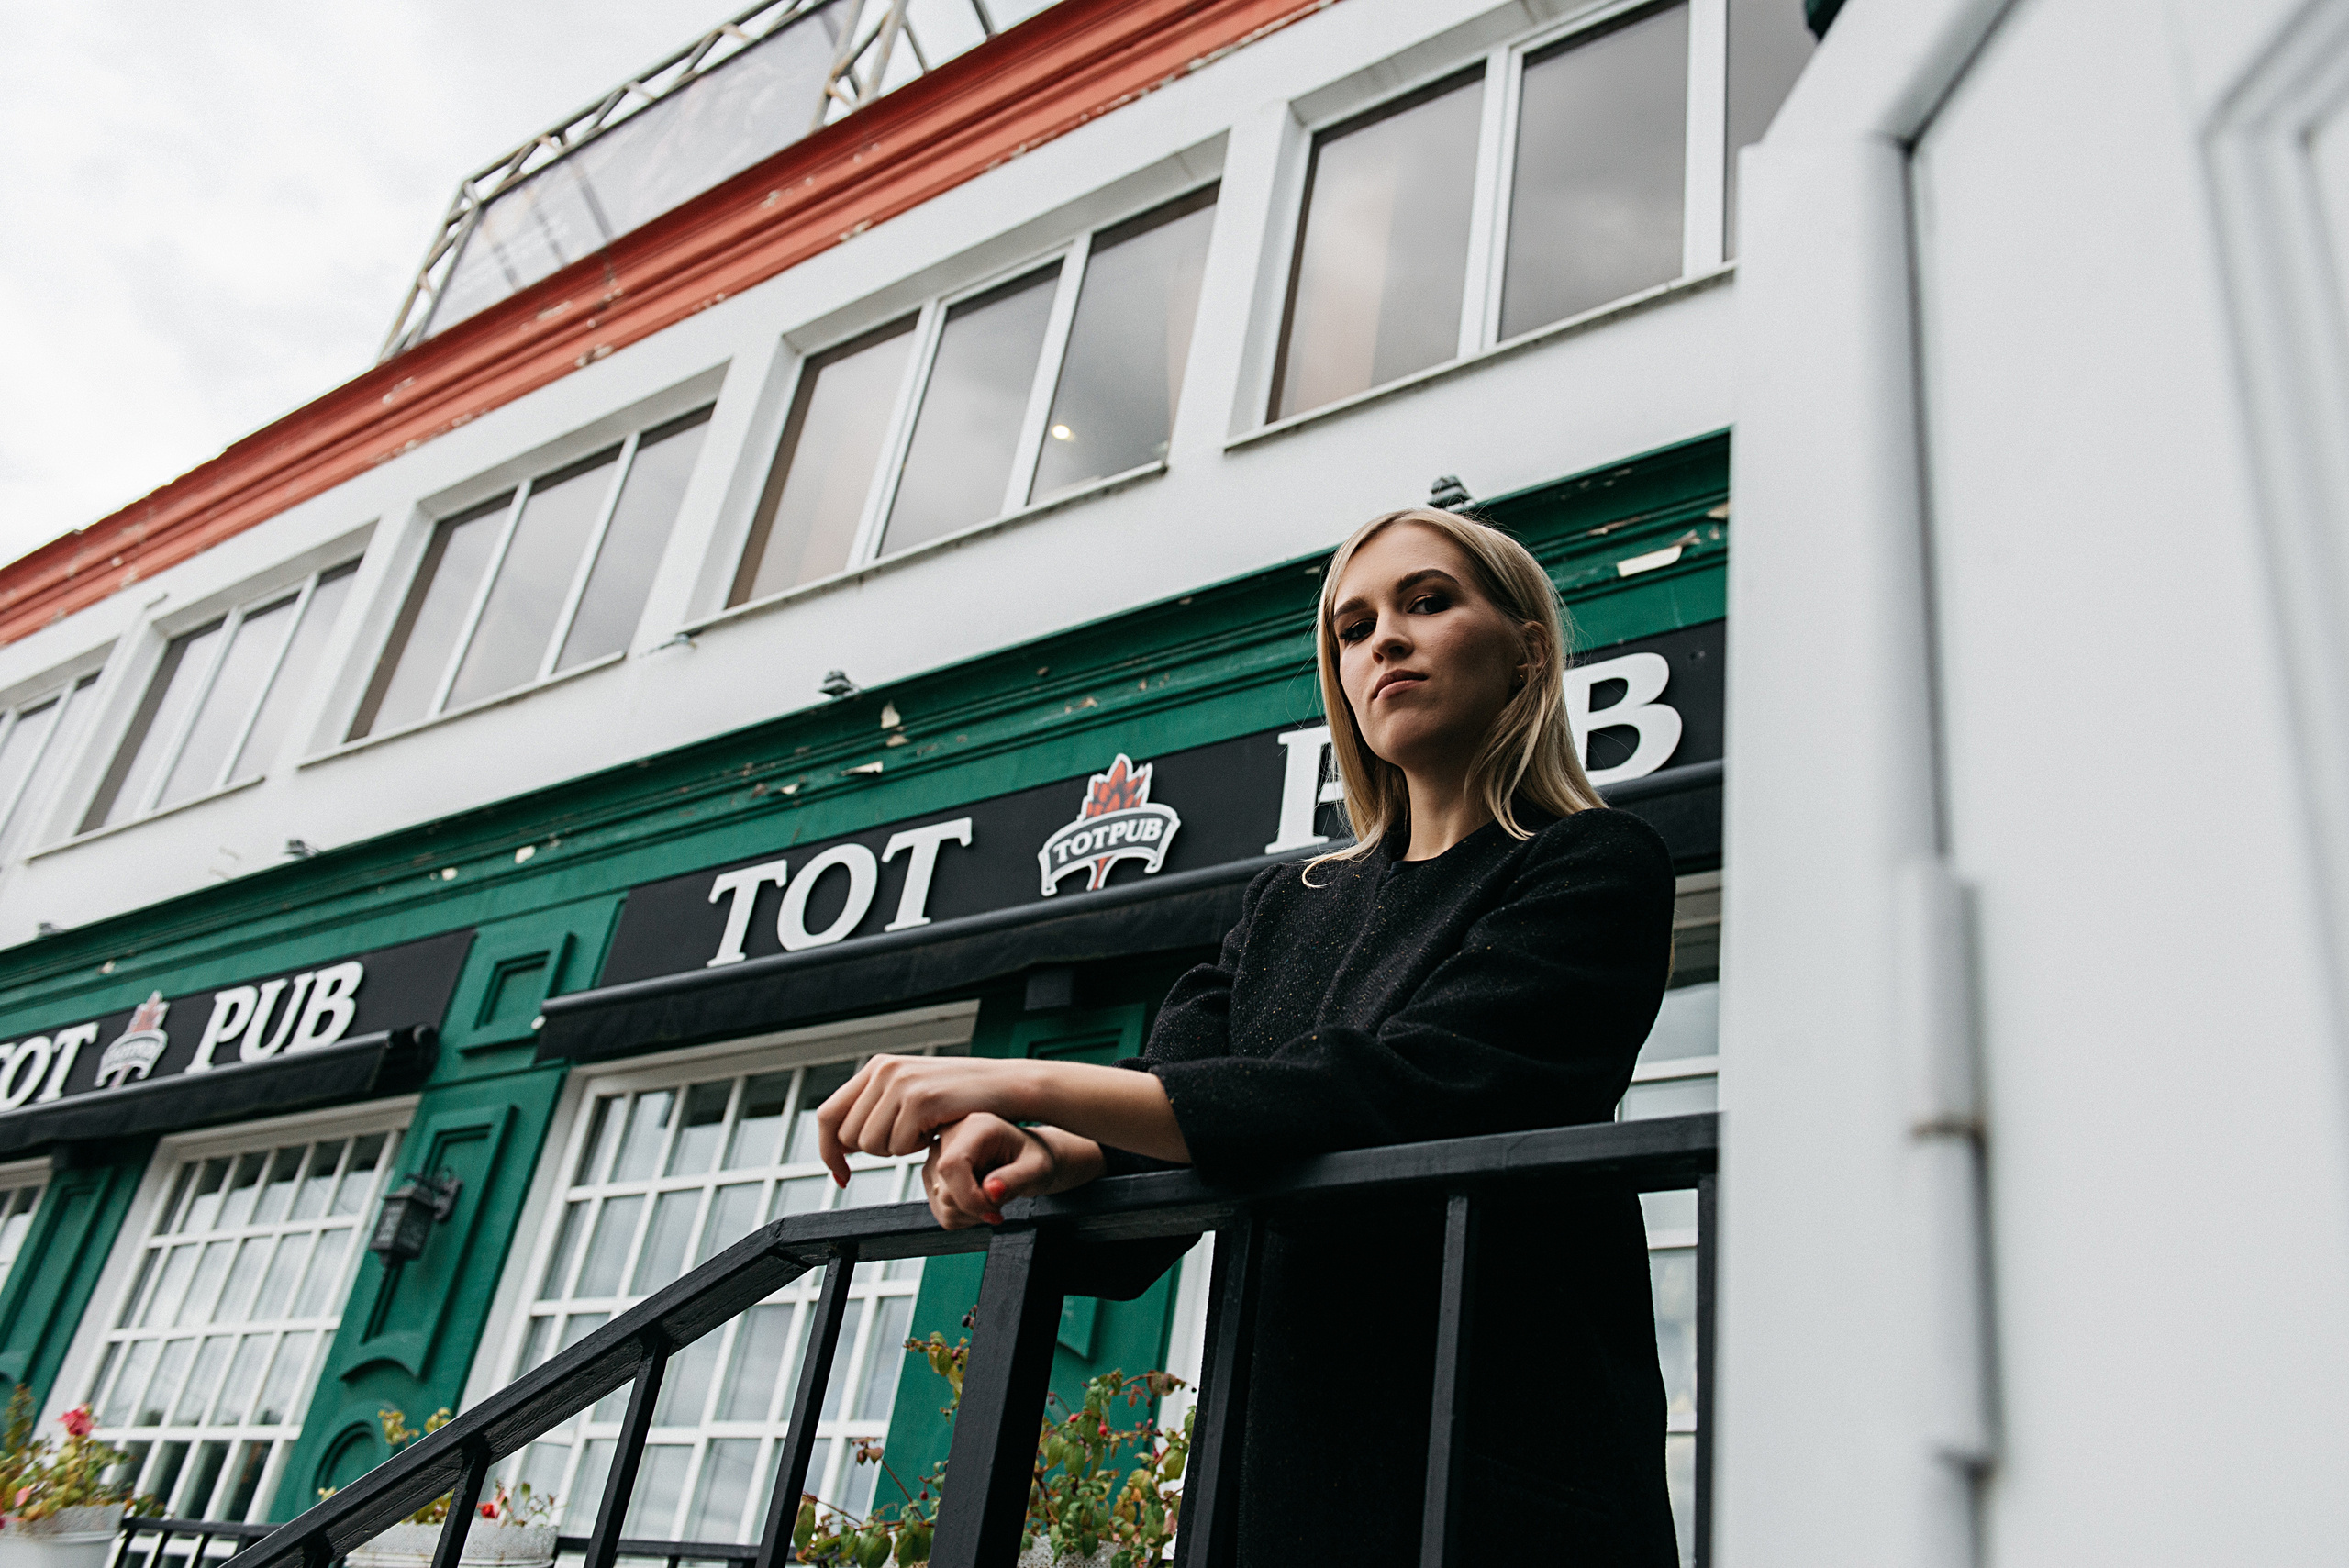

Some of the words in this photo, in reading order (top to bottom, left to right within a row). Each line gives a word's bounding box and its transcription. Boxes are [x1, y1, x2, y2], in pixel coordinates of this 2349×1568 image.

[707, 817, 972, 968] TOT
[1264, 652, 1683, 854] PB
[1052, 817, 1163, 864] TOTPUB
[0, 1021, 99, 1113] OT
[184, 961, 364, 1074] PUB
